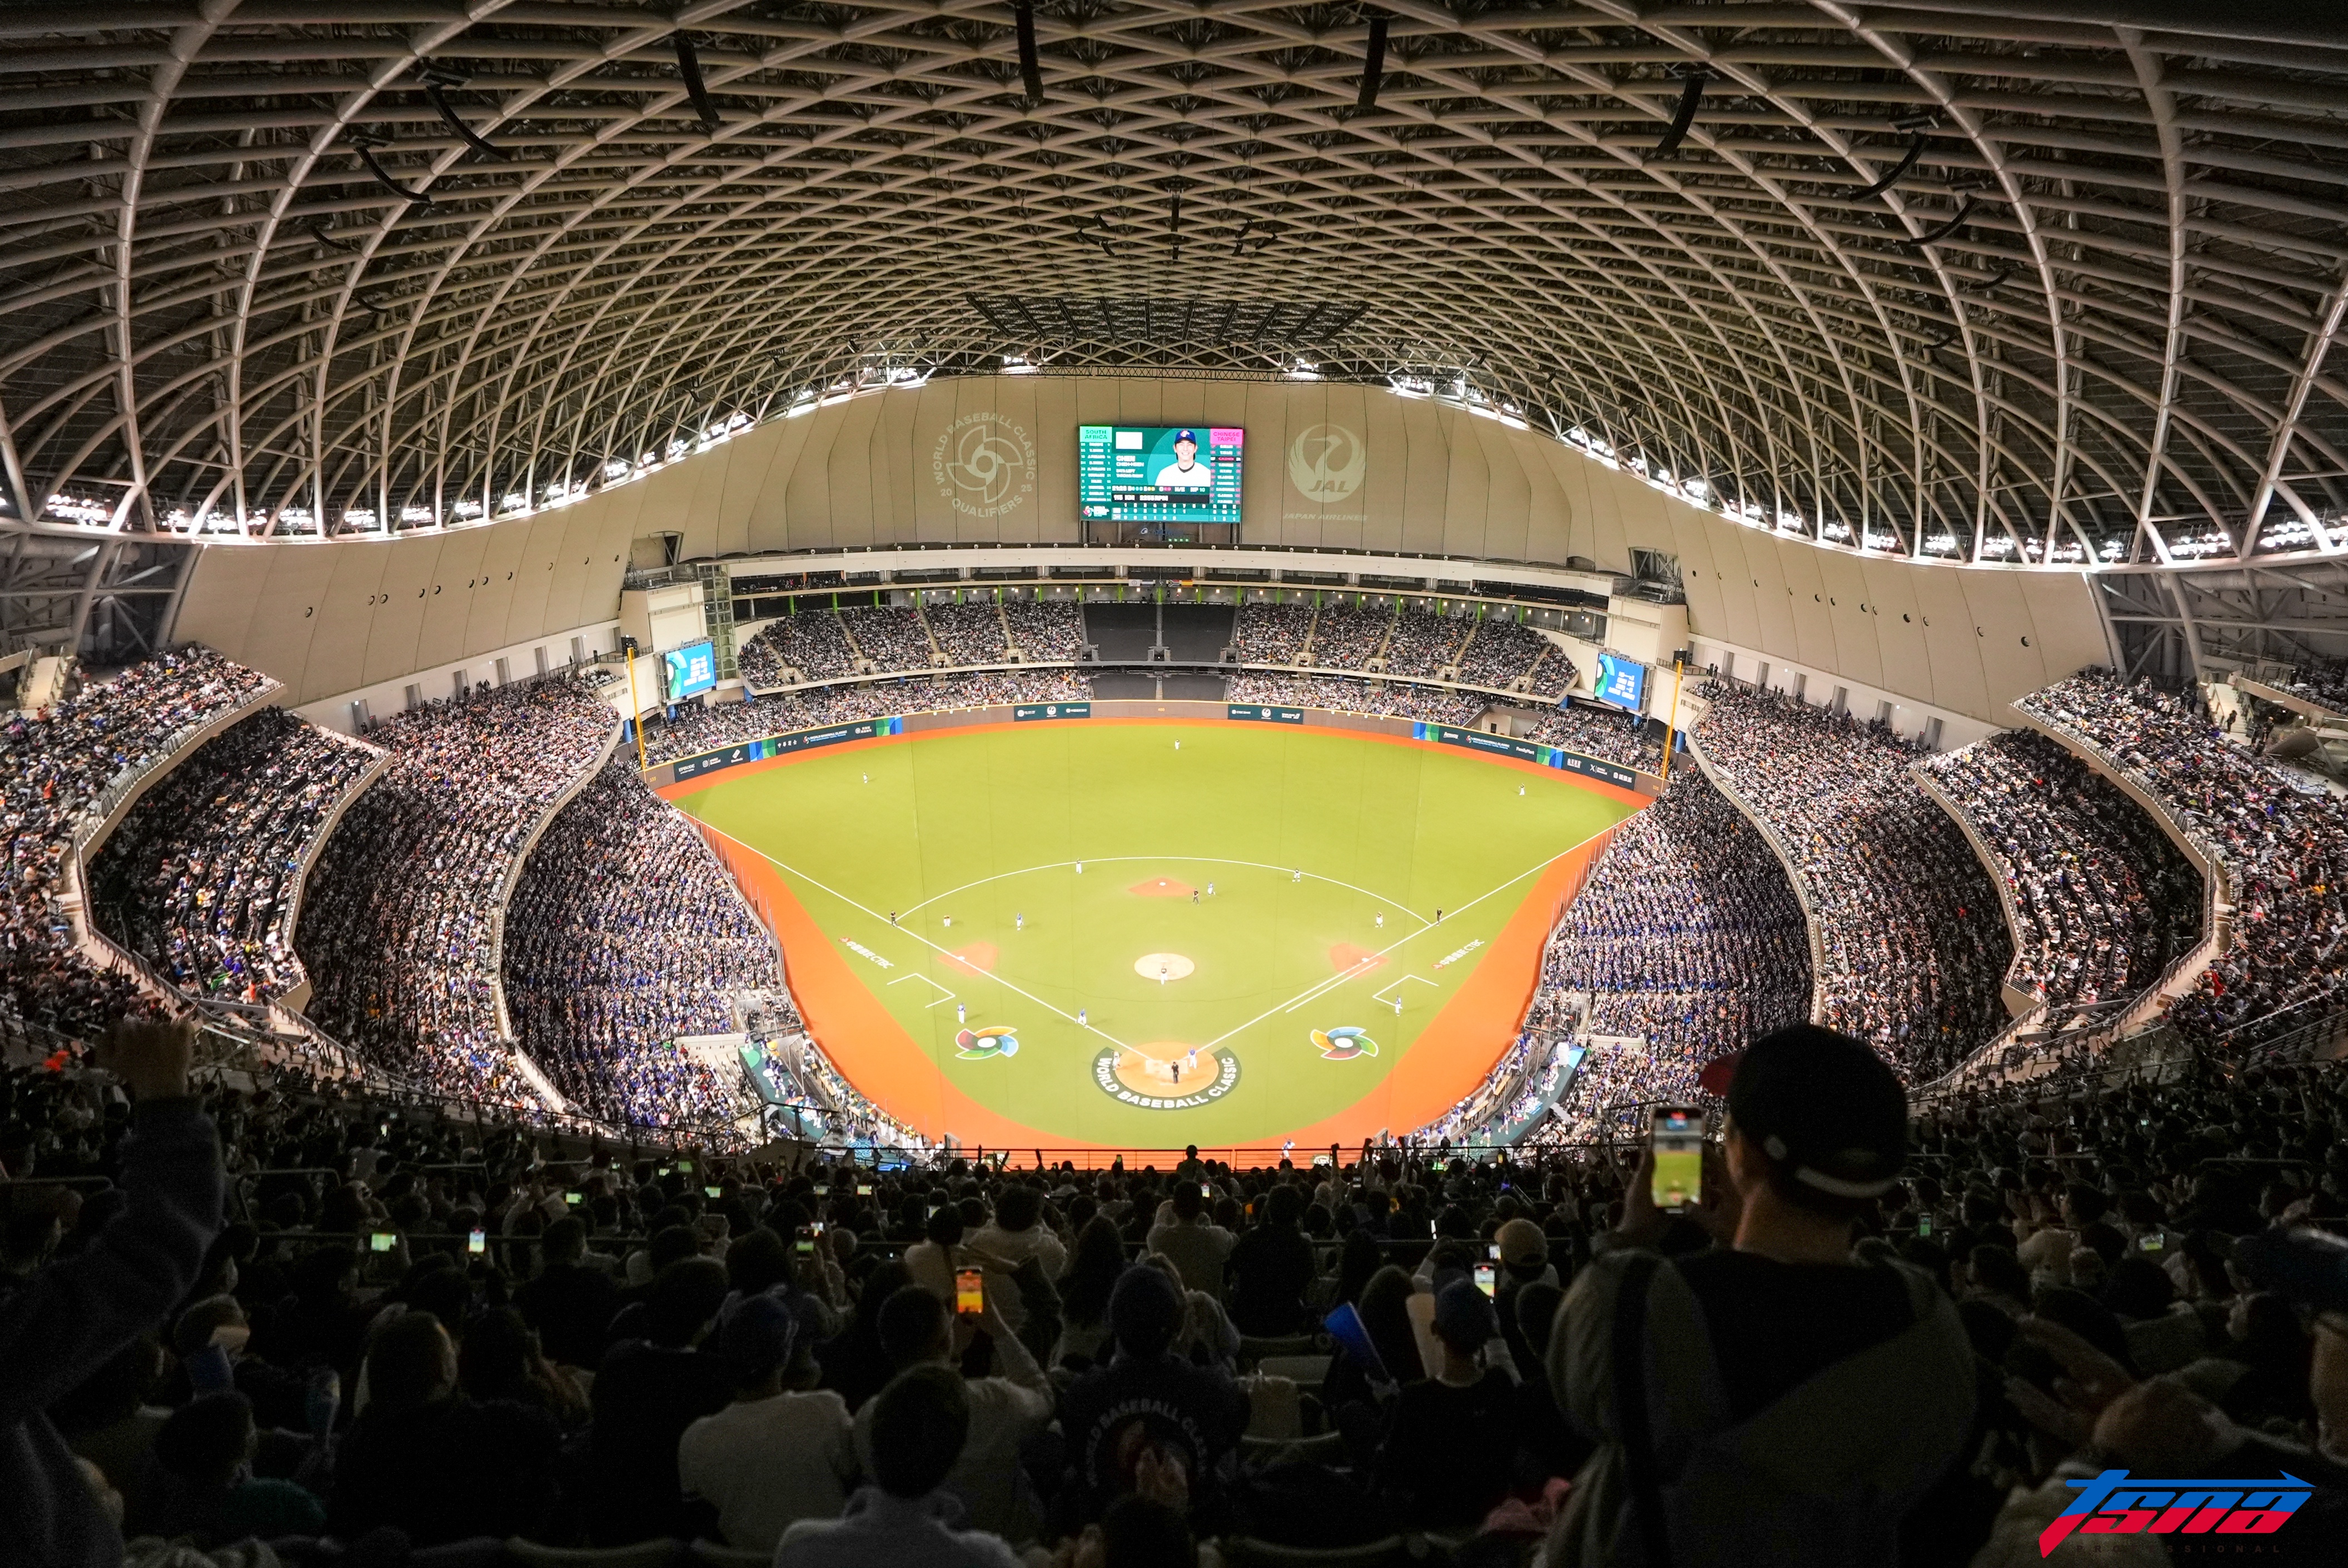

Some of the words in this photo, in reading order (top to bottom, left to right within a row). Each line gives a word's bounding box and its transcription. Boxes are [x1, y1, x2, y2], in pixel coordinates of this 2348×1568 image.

[933, 434, 948, 485] WORLD
[946, 412, 1012, 435] BASEBALL
[1013, 426, 1036, 480] CLASSIC
[940, 488, 952, 496] 20
[1308, 480, 1350, 492] JAL
[952, 495, 1023, 517] QUALIFIERS
[1516, 746, 1535, 755] FamilyMart
[1463, 939, 1485, 951] CTBC
[870, 955, 894, 969] CTBC
[1096, 1057, 1120, 1092] WORLD
[1117, 1091, 1209, 1108] BASEBALL
[1208, 1057, 1237, 1097] CLASSIC
[1098, 1397, 1179, 1429] BASEBALL
